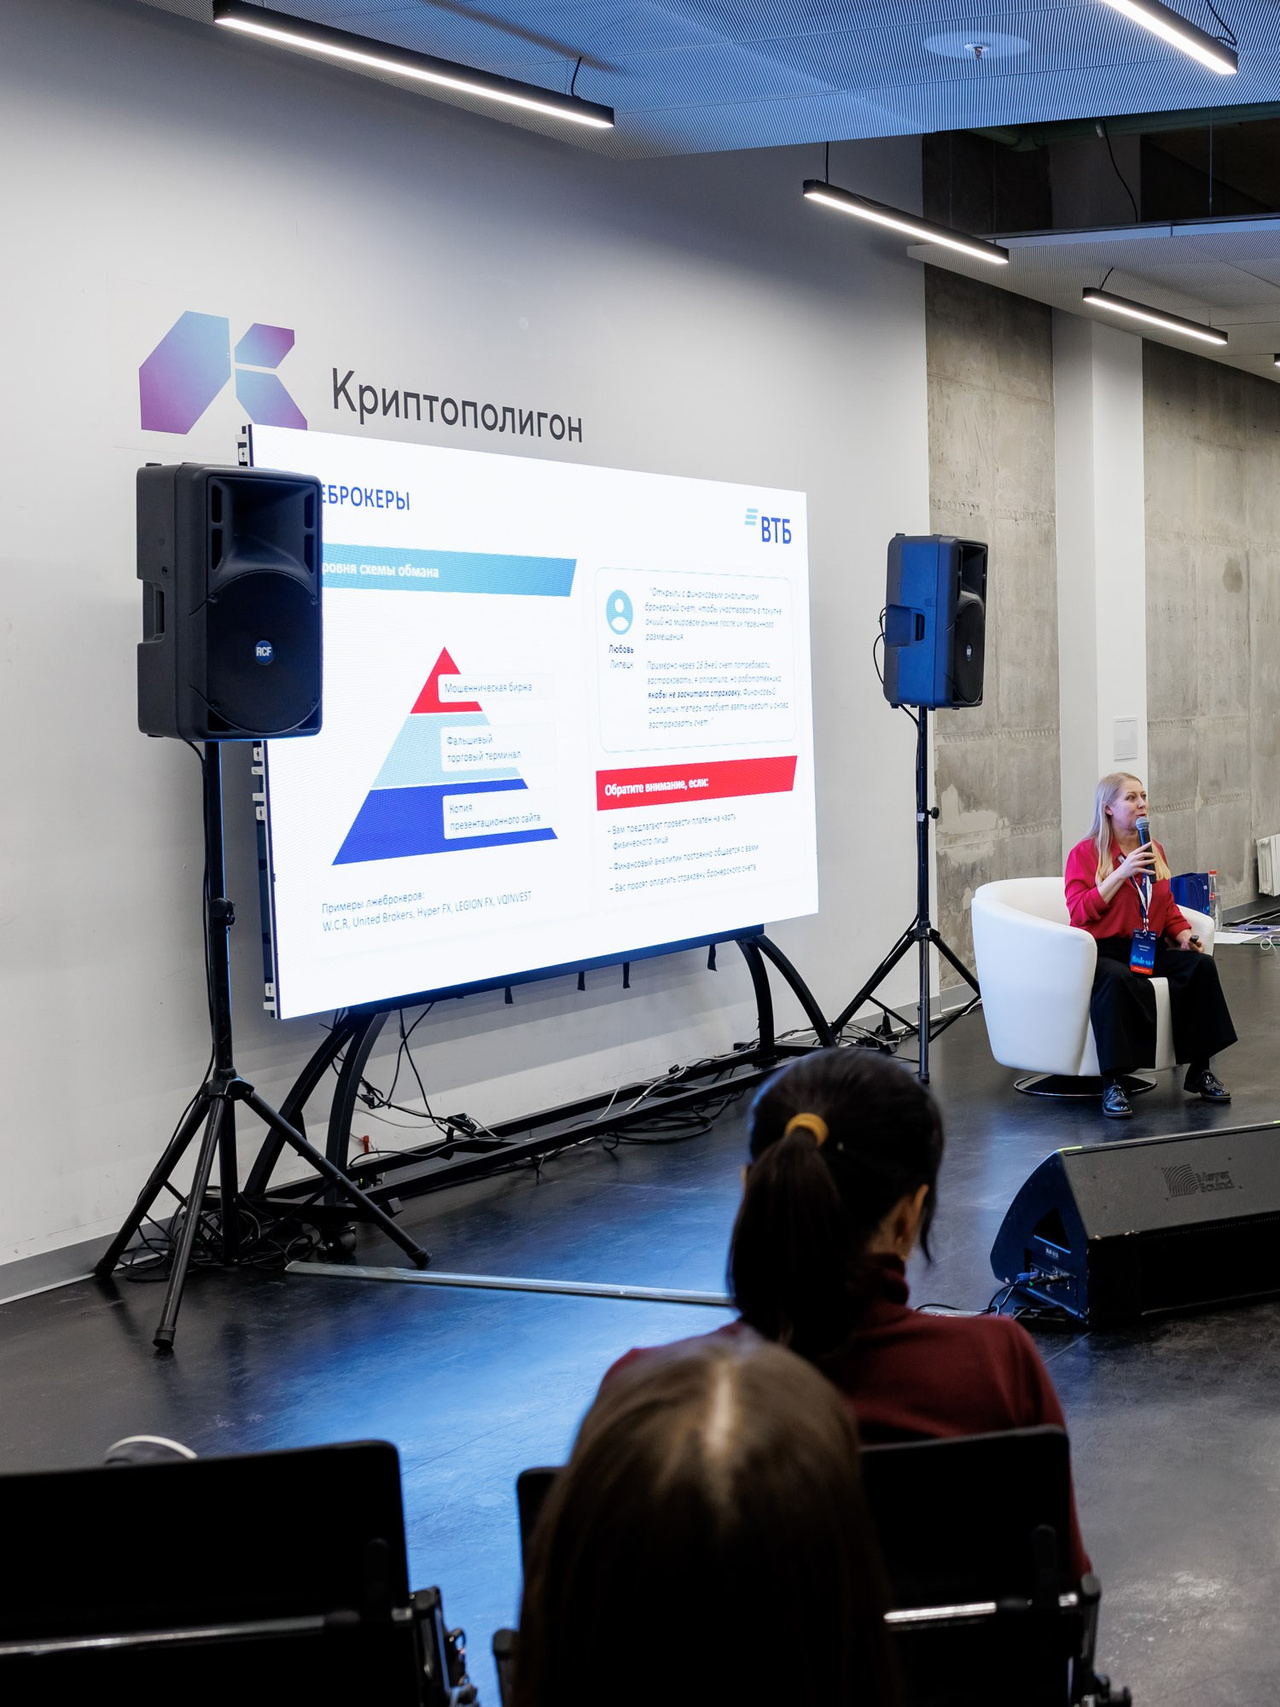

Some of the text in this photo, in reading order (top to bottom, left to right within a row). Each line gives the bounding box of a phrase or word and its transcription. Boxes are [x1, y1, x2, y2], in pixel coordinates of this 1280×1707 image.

[332, 367, 583, 444] Криптополигон
[761, 516, 792, 544] ВТБ
[322, 562, 440, 578] ровня схемы обмана
[256, 646, 272, 657] RCF
[609, 644, 634, 654] Любовь
[444, 681, 533, 694] Мошенническая биржа
[647, 689, 667, 699] якобы
[669, 691, 676, 699] не
[447, 734, 493, 746] Фальшивый
[447, 750, 522, 763] торговый терминал
[605, 778, 709, 798] Обратите внимание, если:
[449, 804, 473, 814] Копия
[450, 813, 541, 831] презентационного сайта
[322, 891, 426, 914] Примеры лжеброкеров:
[353, 914, 381, 928] United
[382, 911, 415, 923] Brokers,
[417, 906, 440, 919] Hyper
[442, 903, 453, 914] FX,
[455, 899, 483, 912] LEGION
[484, 897, 495, 909] FX,
[497, 891, 532, 905] VQINVEST
